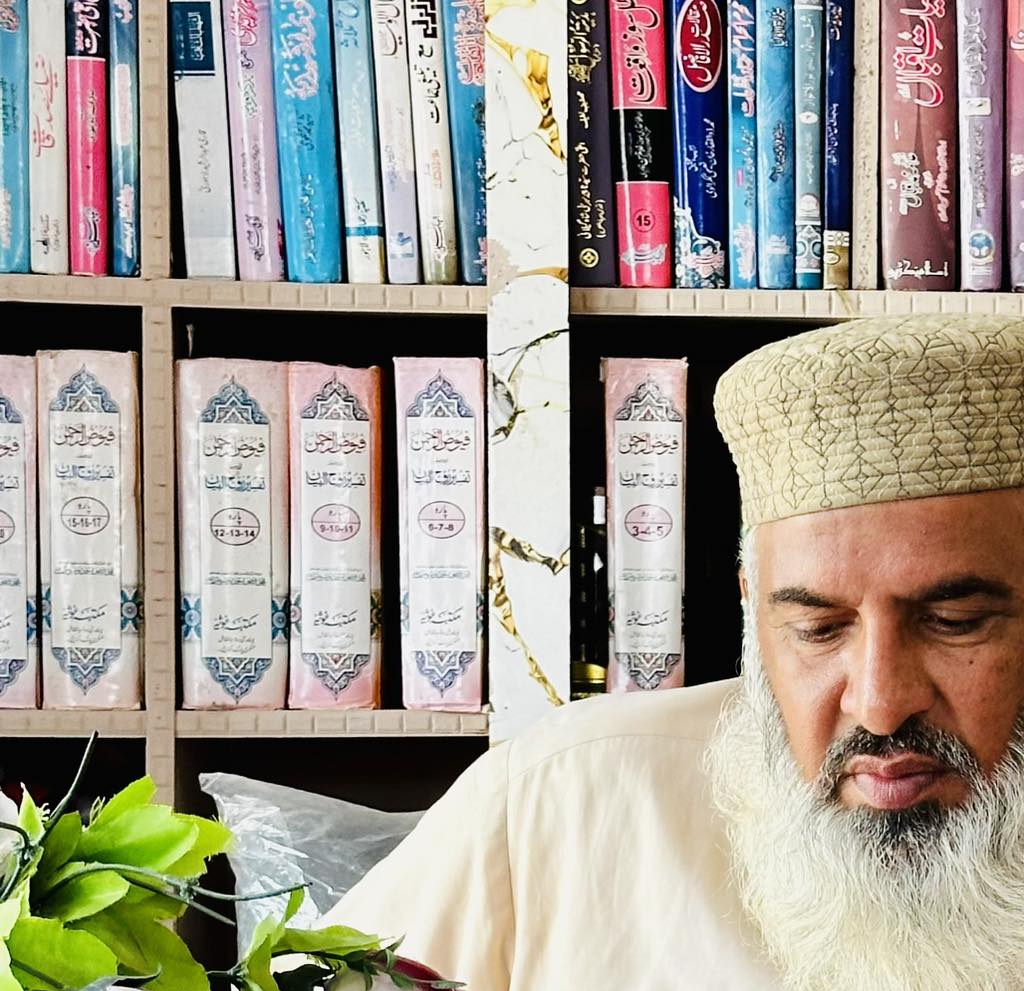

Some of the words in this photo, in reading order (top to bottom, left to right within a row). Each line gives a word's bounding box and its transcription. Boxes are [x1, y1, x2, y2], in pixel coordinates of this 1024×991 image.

[622, 12, 646, 44] سوز
[636, 217, 651, 227] 15
[214, 528, 256, 538] 12-13-14
[631, 525, 665, 537] 3-4-5
